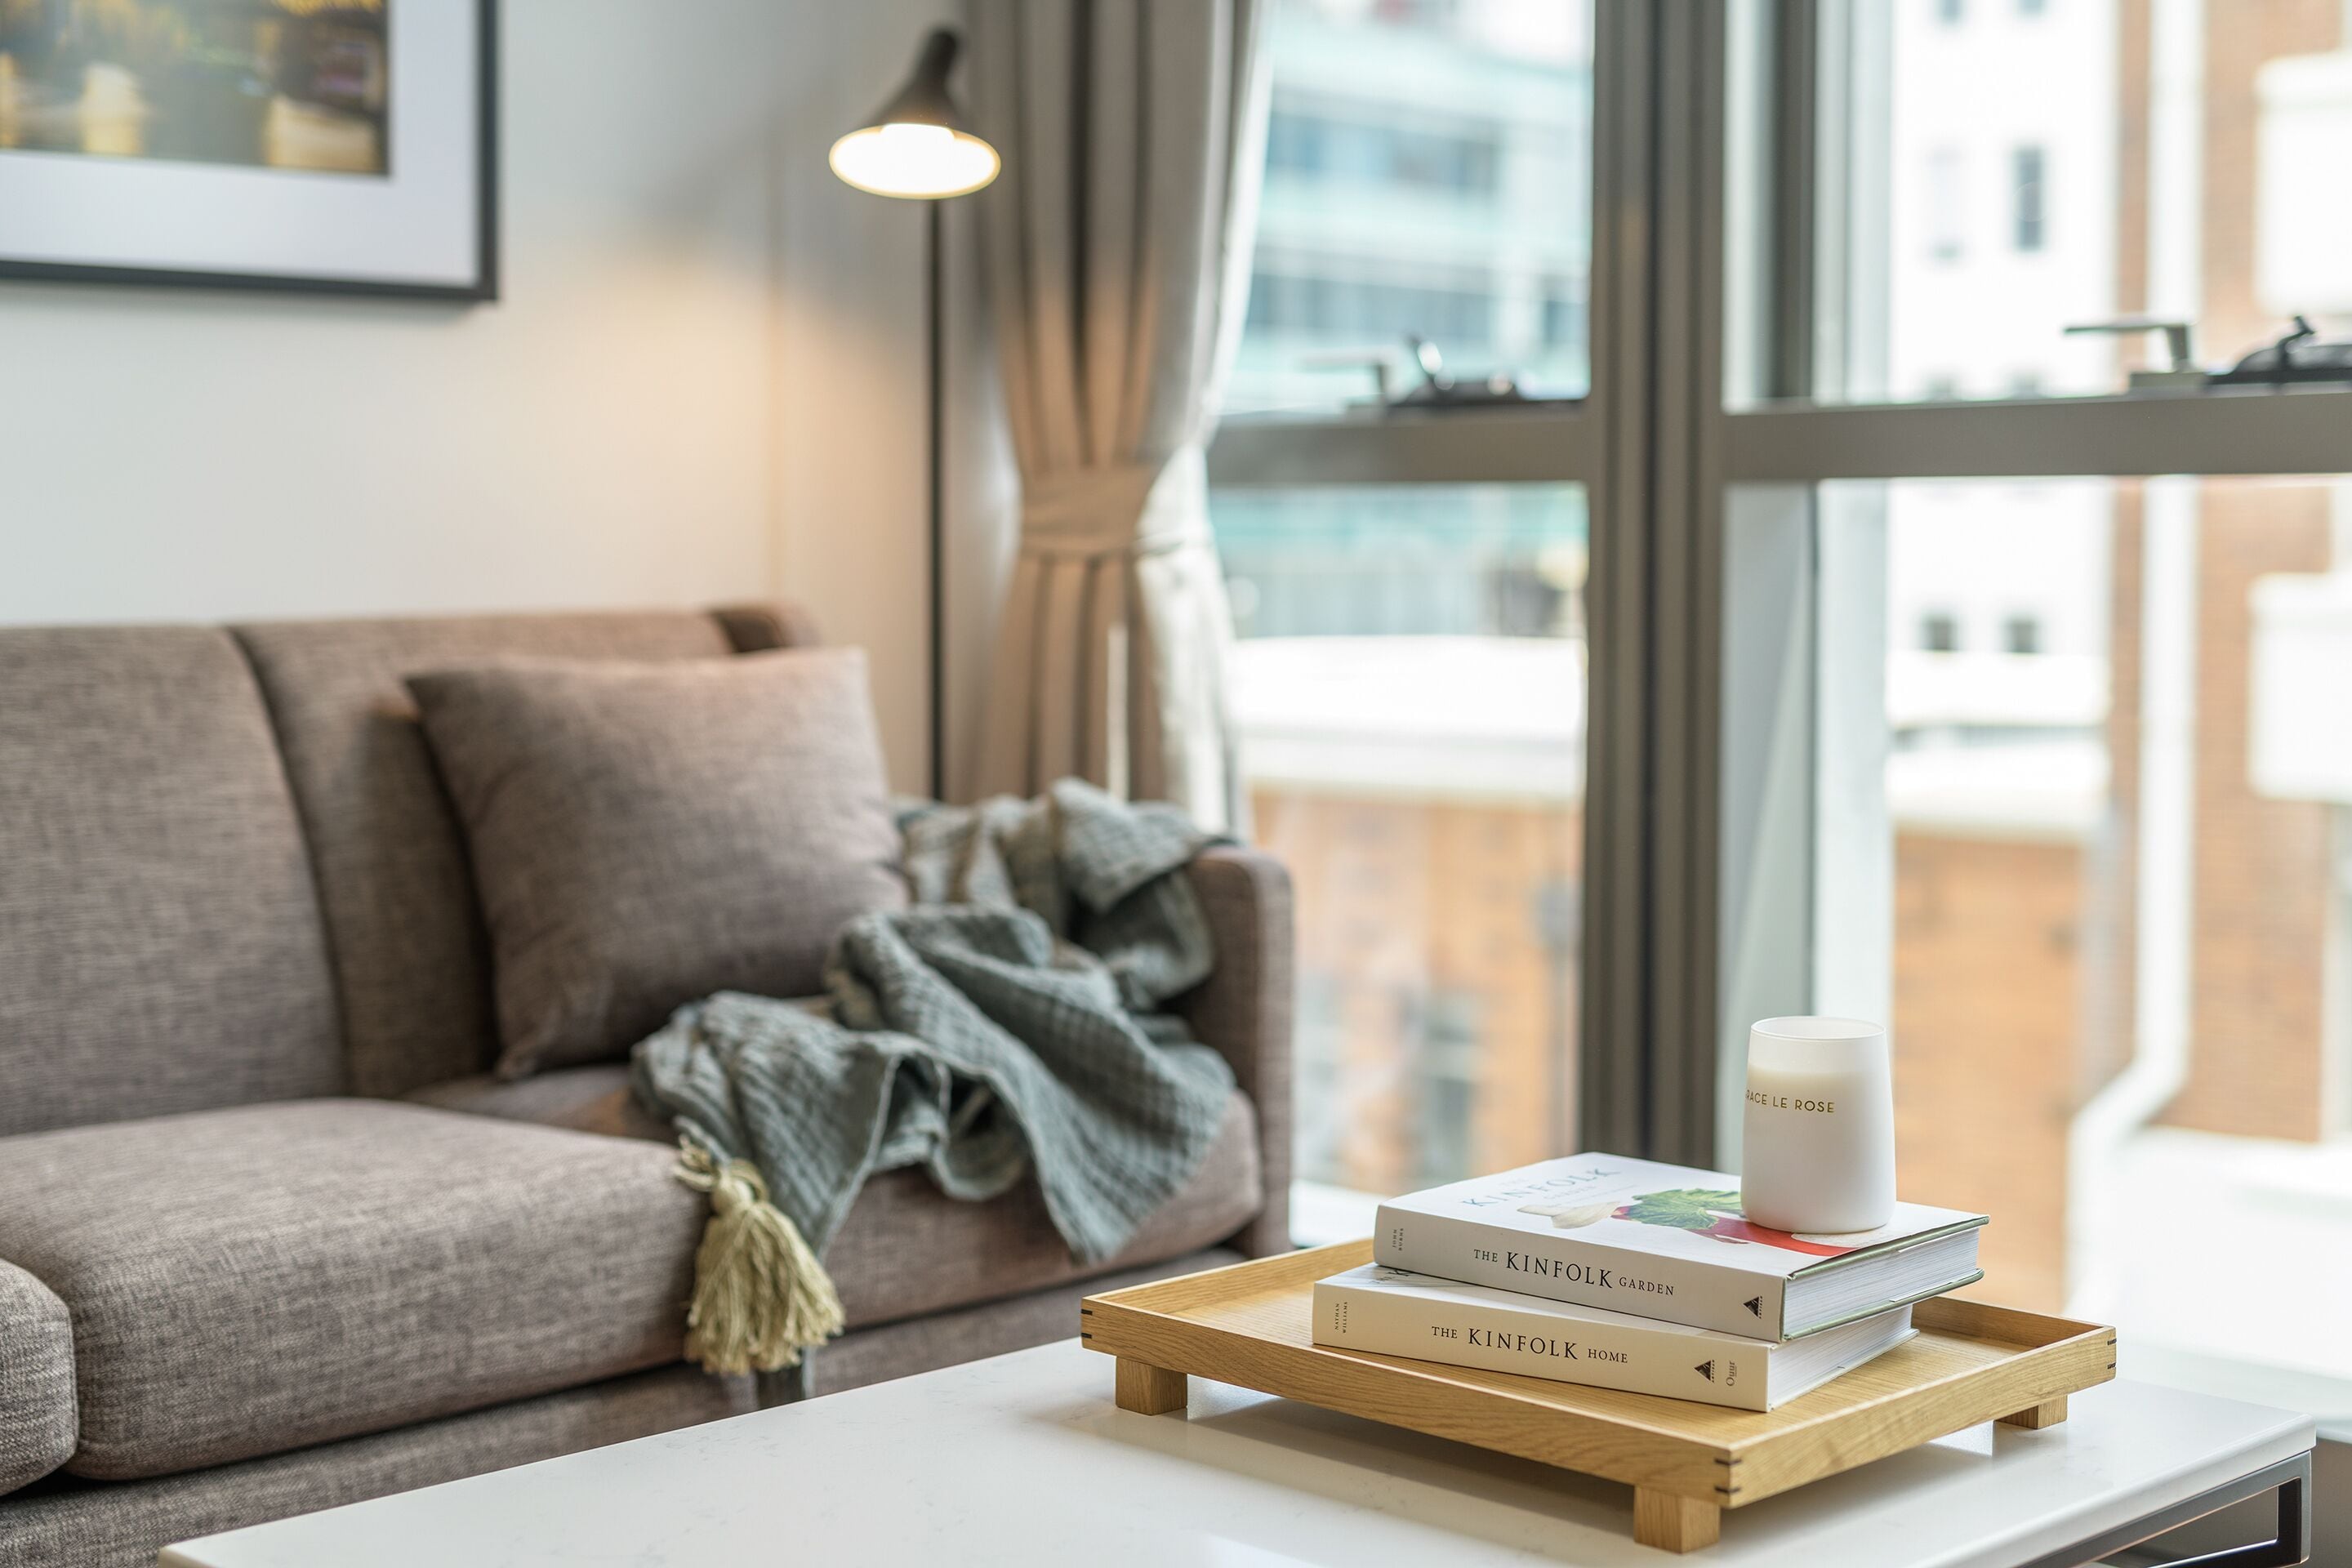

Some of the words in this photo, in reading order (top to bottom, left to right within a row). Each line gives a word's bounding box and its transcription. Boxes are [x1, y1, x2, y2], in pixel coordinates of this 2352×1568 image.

[1745, 1089, 1767, 1105] RACE
[1772, 1096, 1788, 1108] LE
[1794, 1098, 1835, 1113] ROSE
[1462, 1168, 1621, 1207] KINFOLK
[1473, 1249, 1499, 1263] THE
[1506, 1251, 1613, 1289] KINFOLK
[1619, 1276, 1674, 1296] GARDEN
[1431, 1325, 1458, 1339] THE
[1468, 1327, 1578, 1360] KINFOLK
[1588, 1348, 1628, 1364] HOME
